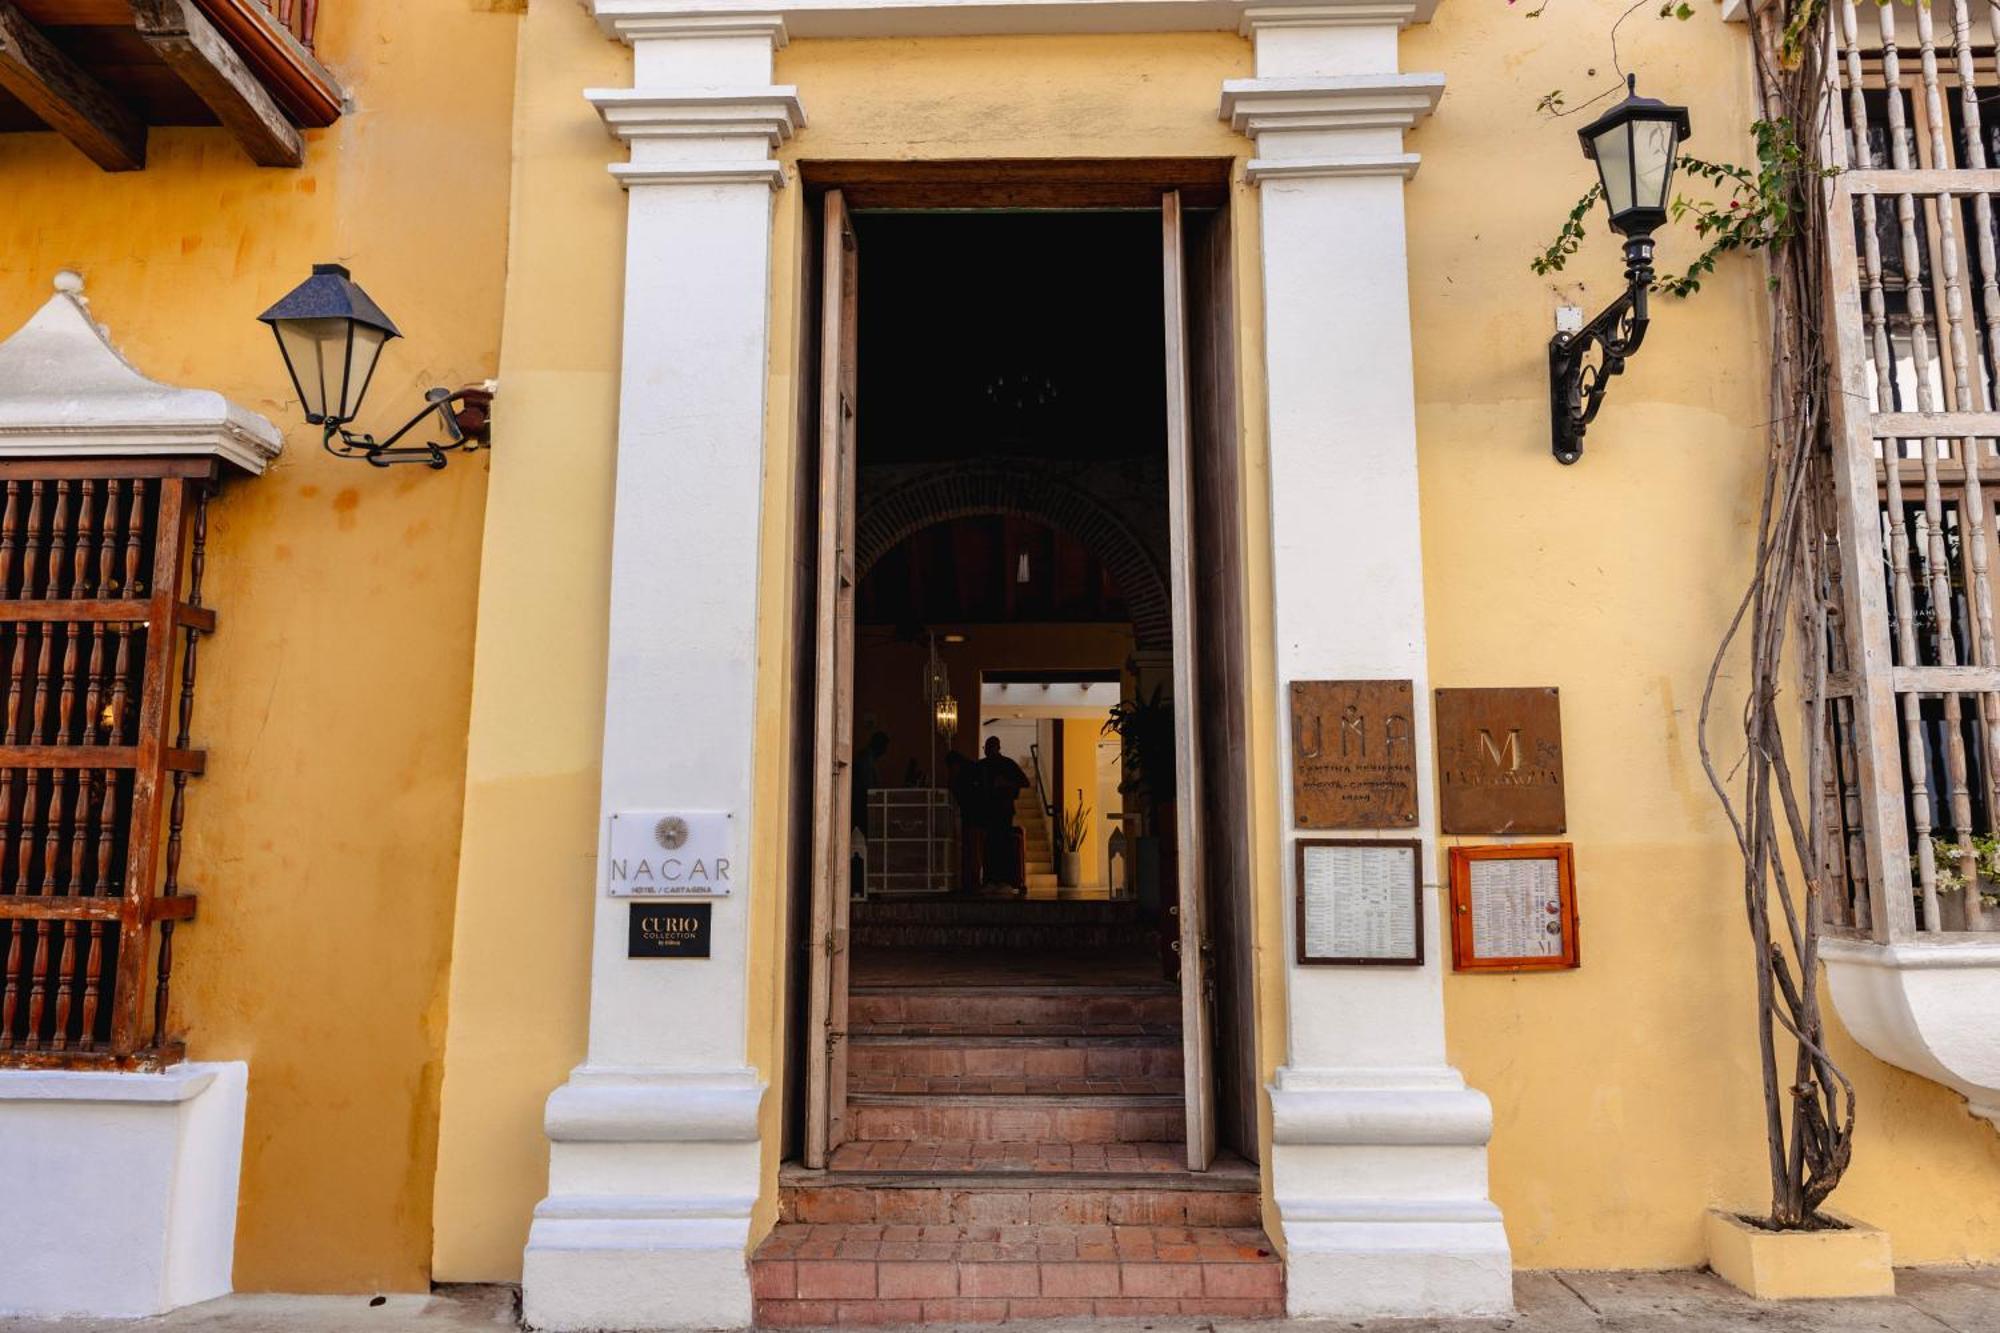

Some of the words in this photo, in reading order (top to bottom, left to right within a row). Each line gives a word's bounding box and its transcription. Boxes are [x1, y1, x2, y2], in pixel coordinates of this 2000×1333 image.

[1477, 728, 1522, 771] M
[611, 858, 730, 880] NACAR
[641, 917, 698, 932] CURIO
